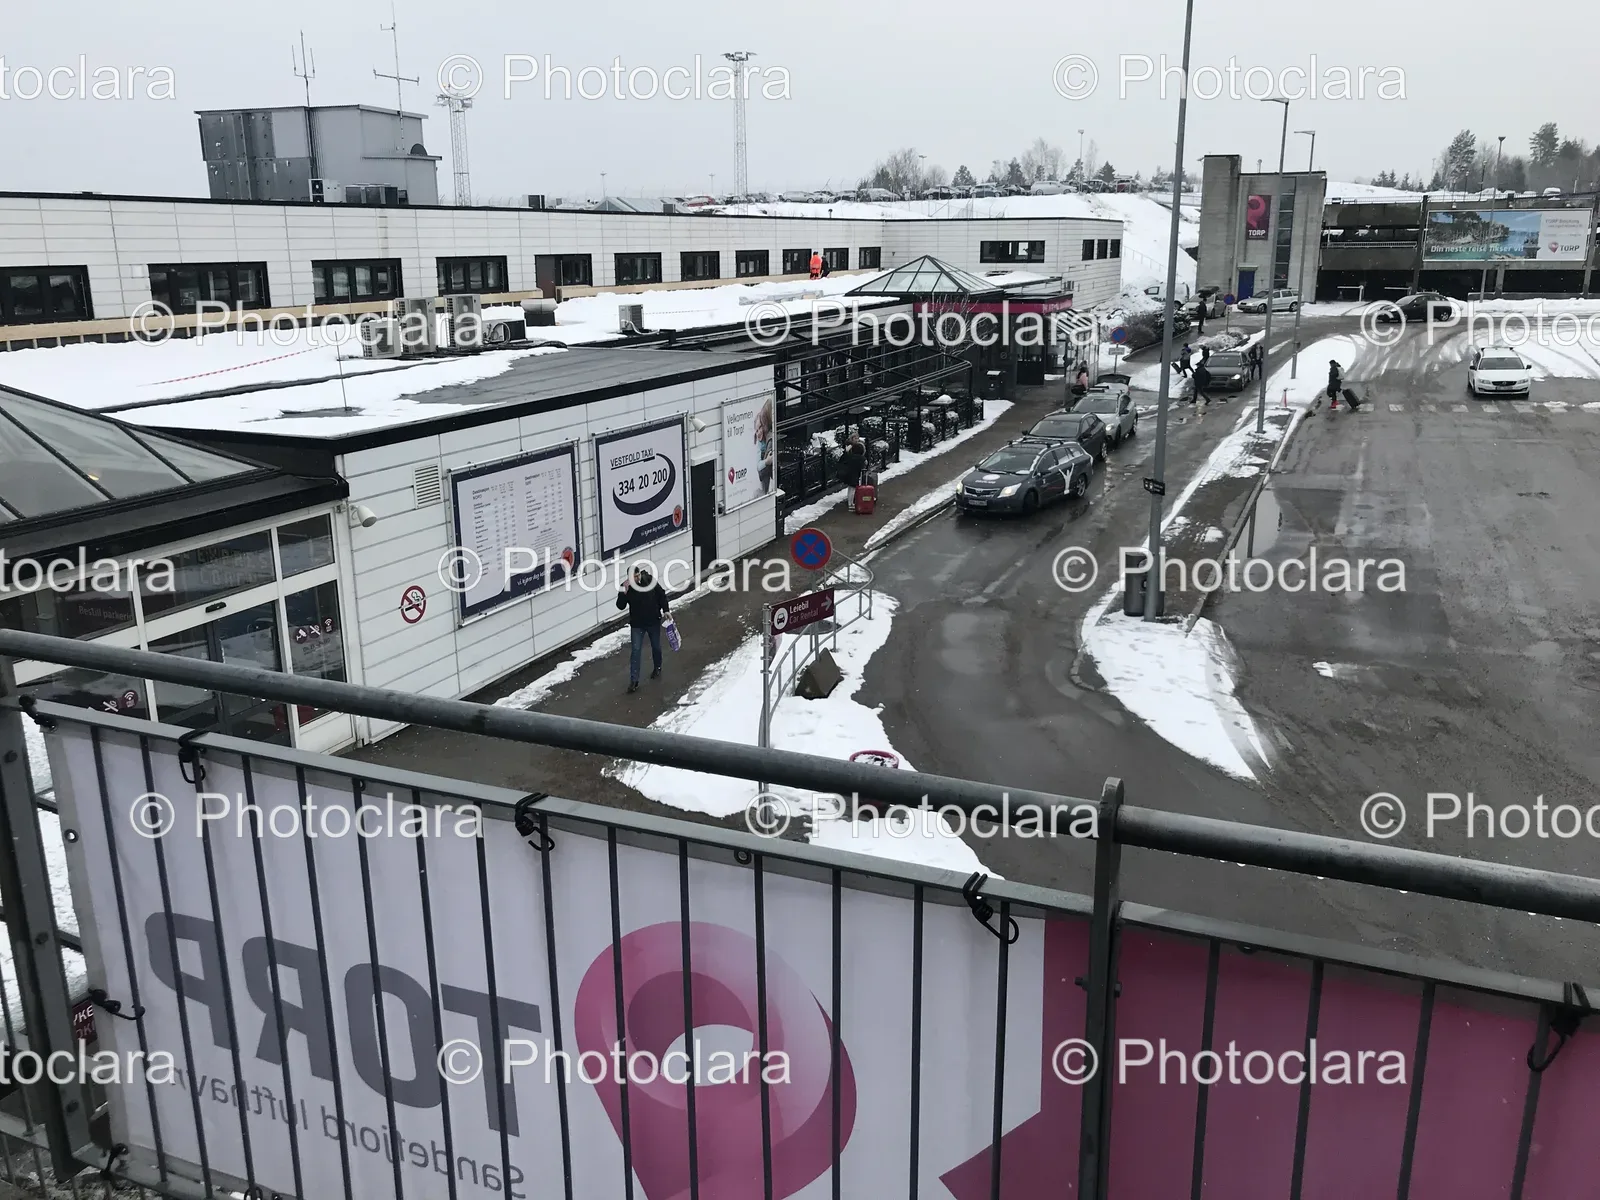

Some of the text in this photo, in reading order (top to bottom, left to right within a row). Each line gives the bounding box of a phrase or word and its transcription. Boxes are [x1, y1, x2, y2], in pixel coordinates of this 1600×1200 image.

[726, 411, 754, 425] Velkommen
[610, 448, 654, 468] VESTFOLD TAXI
[735, 468, 748, 480] TORP
[618, 468, 668, 496] 334 20 200
[78, 605, 102, 617] Bestill
[789, 601, 809, 613] Leiebil
[789, 608, 819, 624] Car Rental
